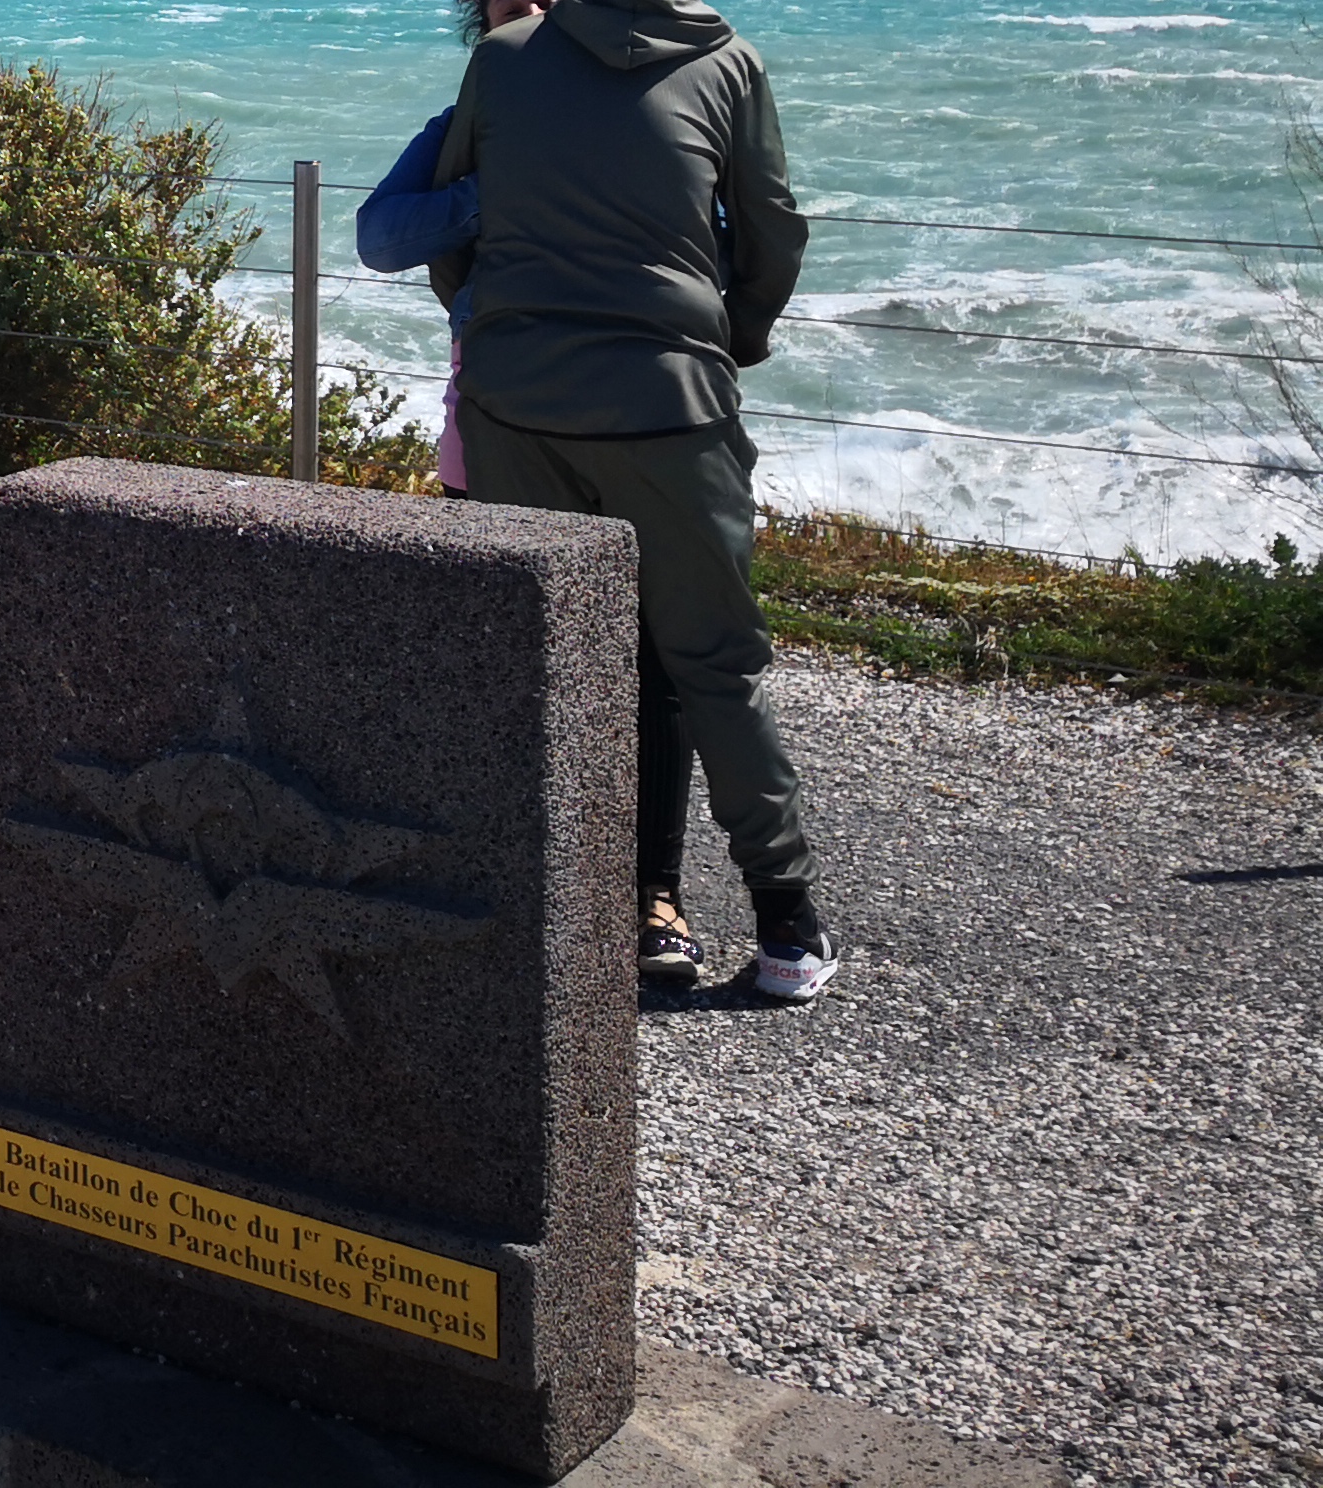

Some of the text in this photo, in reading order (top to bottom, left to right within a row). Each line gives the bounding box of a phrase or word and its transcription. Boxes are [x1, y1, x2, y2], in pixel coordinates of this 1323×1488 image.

[5, 1142, 120, 1197] Bataillon
[129, 1180, 159, 1208] de
[169, 1192, 237, 1231] Choc
[247, 1215, 279, 1244] du
[334, 1239, 470, 1302] Régiment
[29, 1182, 158, 1240] Chasseurs
[169, 1223, 352, 1300] Parachutistes
[362, 1281, 487, 1342] Français
